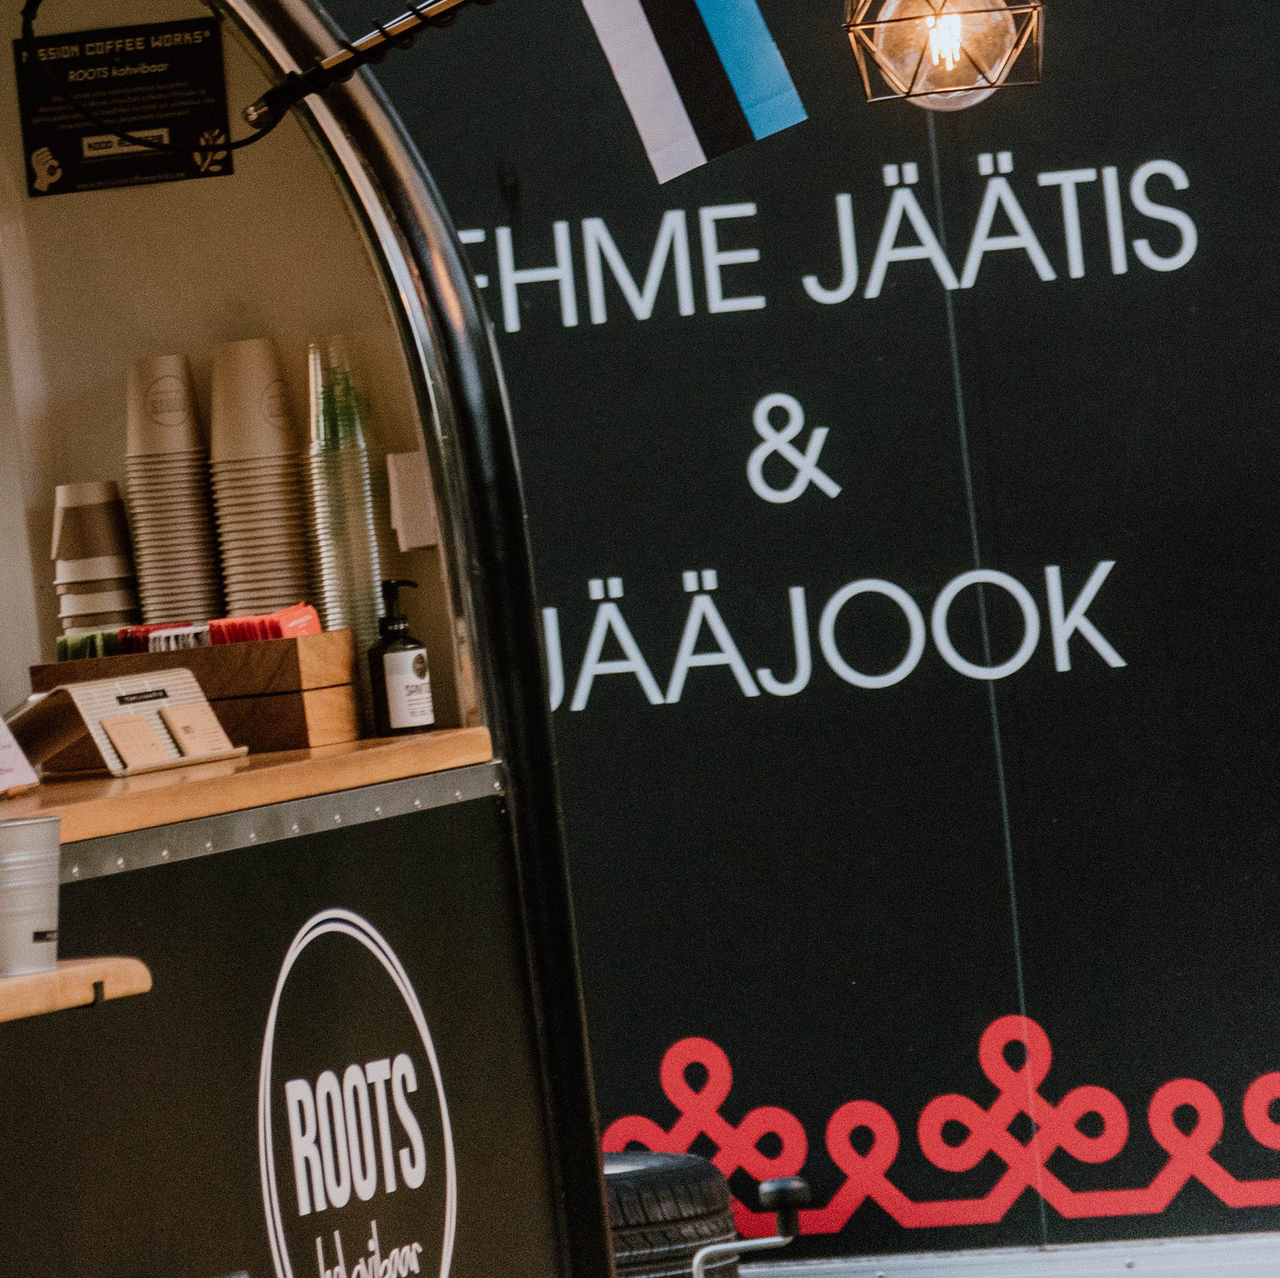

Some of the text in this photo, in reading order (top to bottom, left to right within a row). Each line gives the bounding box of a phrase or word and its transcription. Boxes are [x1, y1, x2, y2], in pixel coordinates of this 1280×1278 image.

[68, 66, 109, 82] ROOTS
[85, 37, 146, 56] COFFEE
[457, 151, 1199, 333] HME JÄÄTIS
[747, 392, 843, 504] &
[542, 560, 1128, 712] JÄÄJOOK
[285, 1053, 426, 1217] ROOTS
